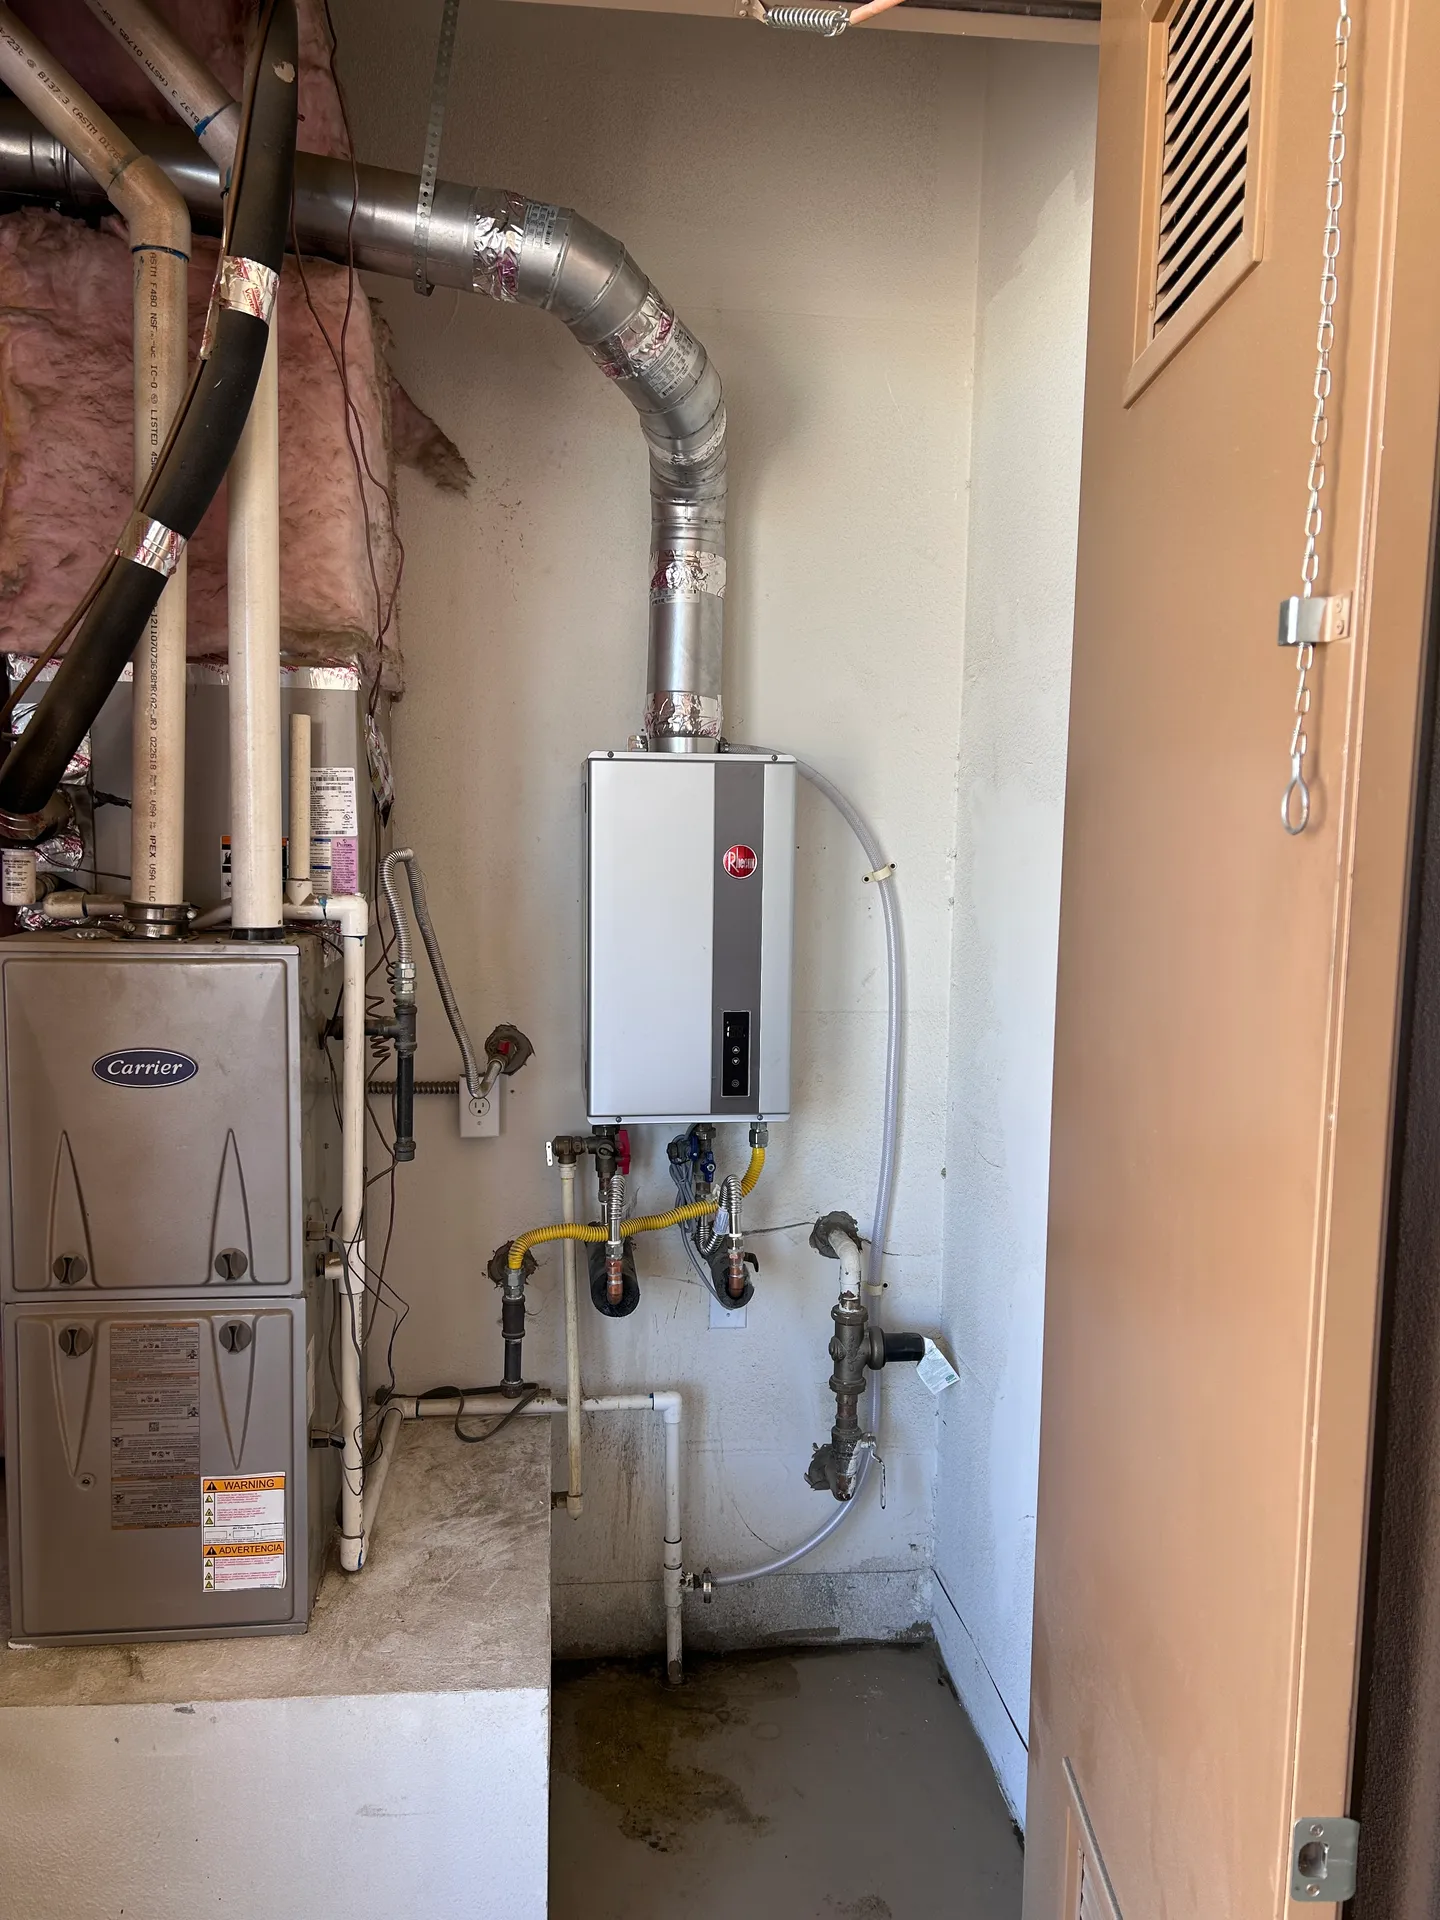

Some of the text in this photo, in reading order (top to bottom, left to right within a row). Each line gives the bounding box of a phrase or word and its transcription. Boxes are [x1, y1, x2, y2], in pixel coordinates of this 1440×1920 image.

[150, 410, 158, 446] LISTED
[149, 736, 157, 770] 022618
[149, 800, 157, 817] USA
[149, 835, 157, 858] IPEX
[149, 863, 157, 881] USA
[148, 885, 156, 902] LLC
[107, 1059, 183, 1076] Carrier
[224, 1479, 275, 1490] WARNING
[218, 1543, 283, 1555] ADVERTENCIA
